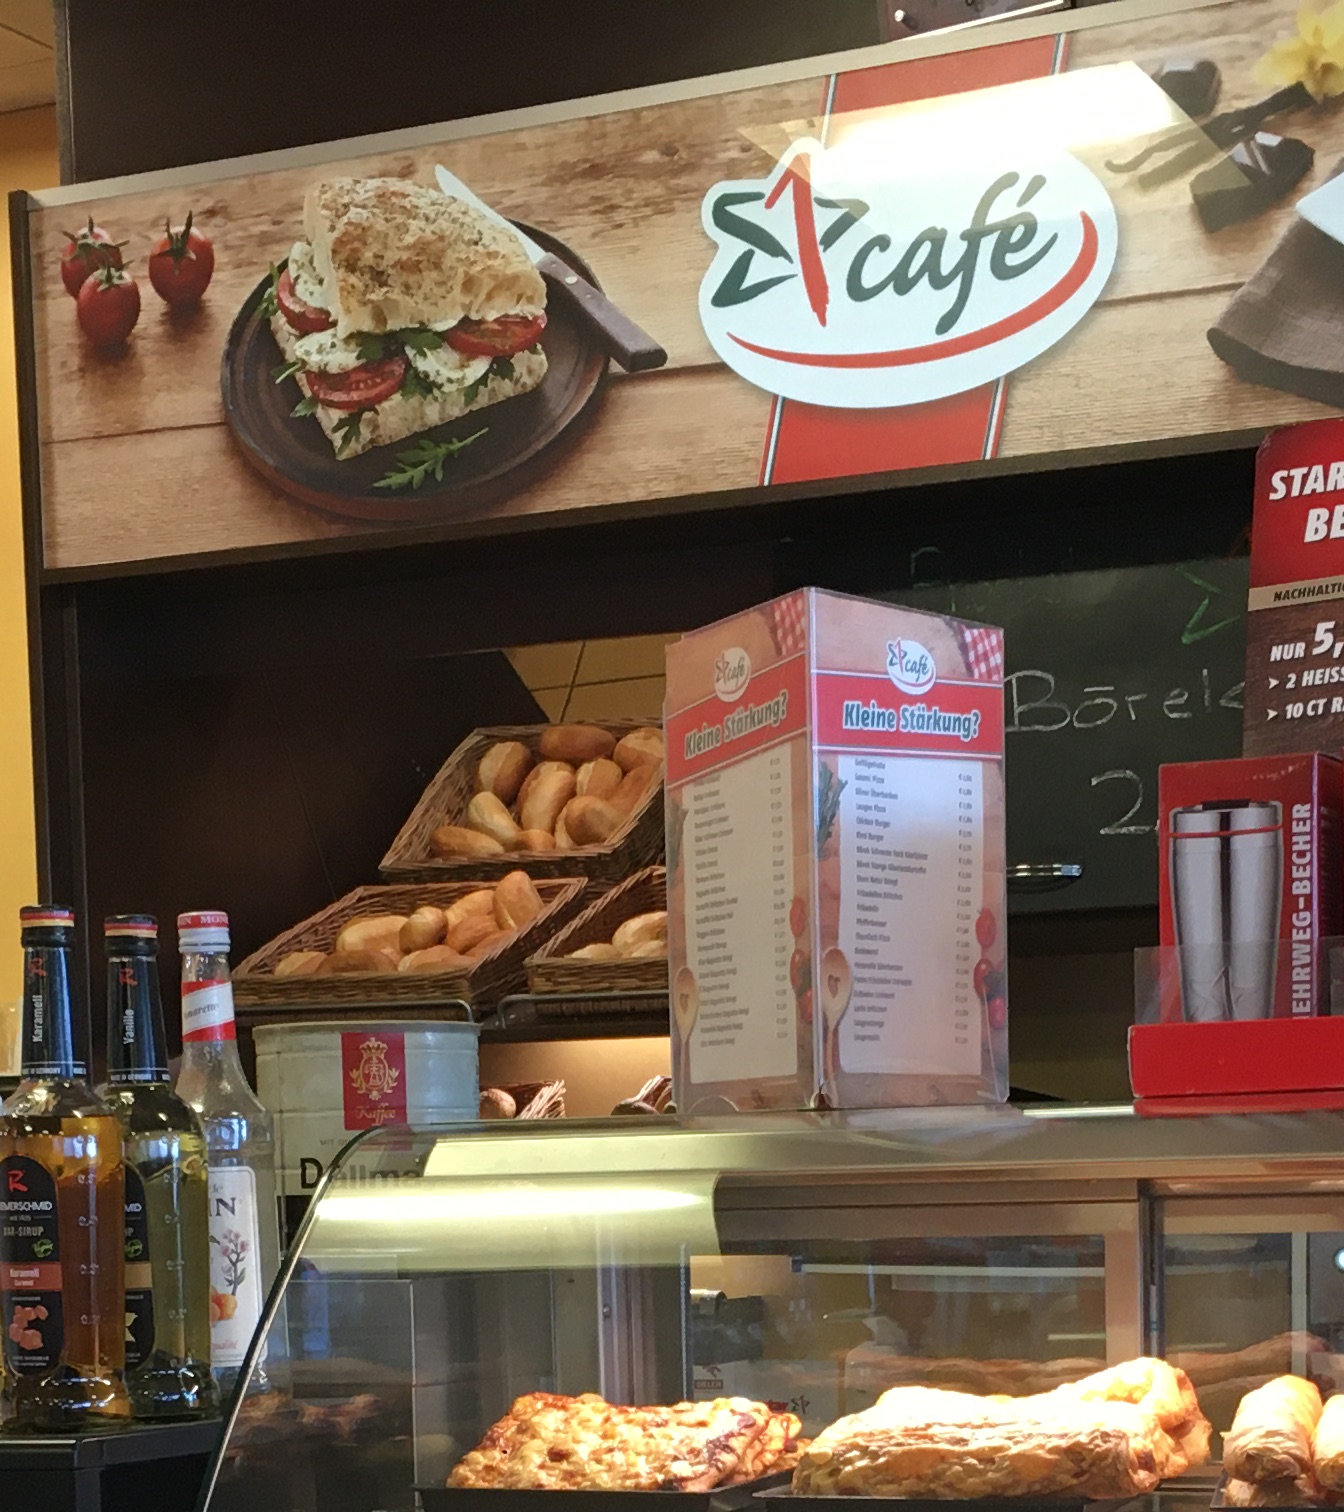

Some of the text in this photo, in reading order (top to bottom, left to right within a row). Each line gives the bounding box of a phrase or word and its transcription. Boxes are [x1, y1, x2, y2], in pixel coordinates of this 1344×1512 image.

[846, 171, 1058, 335] café
[905, 653, 930, 682] café
[1270, 642, 1305, 662] NUR
[1285, 673, 1296, 689] 2
[685, 691, 787, 759] Kleine Stärkung?
[844, 701, 980, 741] Kleine Stärkung?
[1285, 702, 1304, 719] 10
[1307, 699, 1327, 716] CT
[1291, 803, 1312, 1019] EHRWEG-BECHER
[32, 994, 43, 1042] Karamell
[356, 1102, 396, 1126] Kaffee
